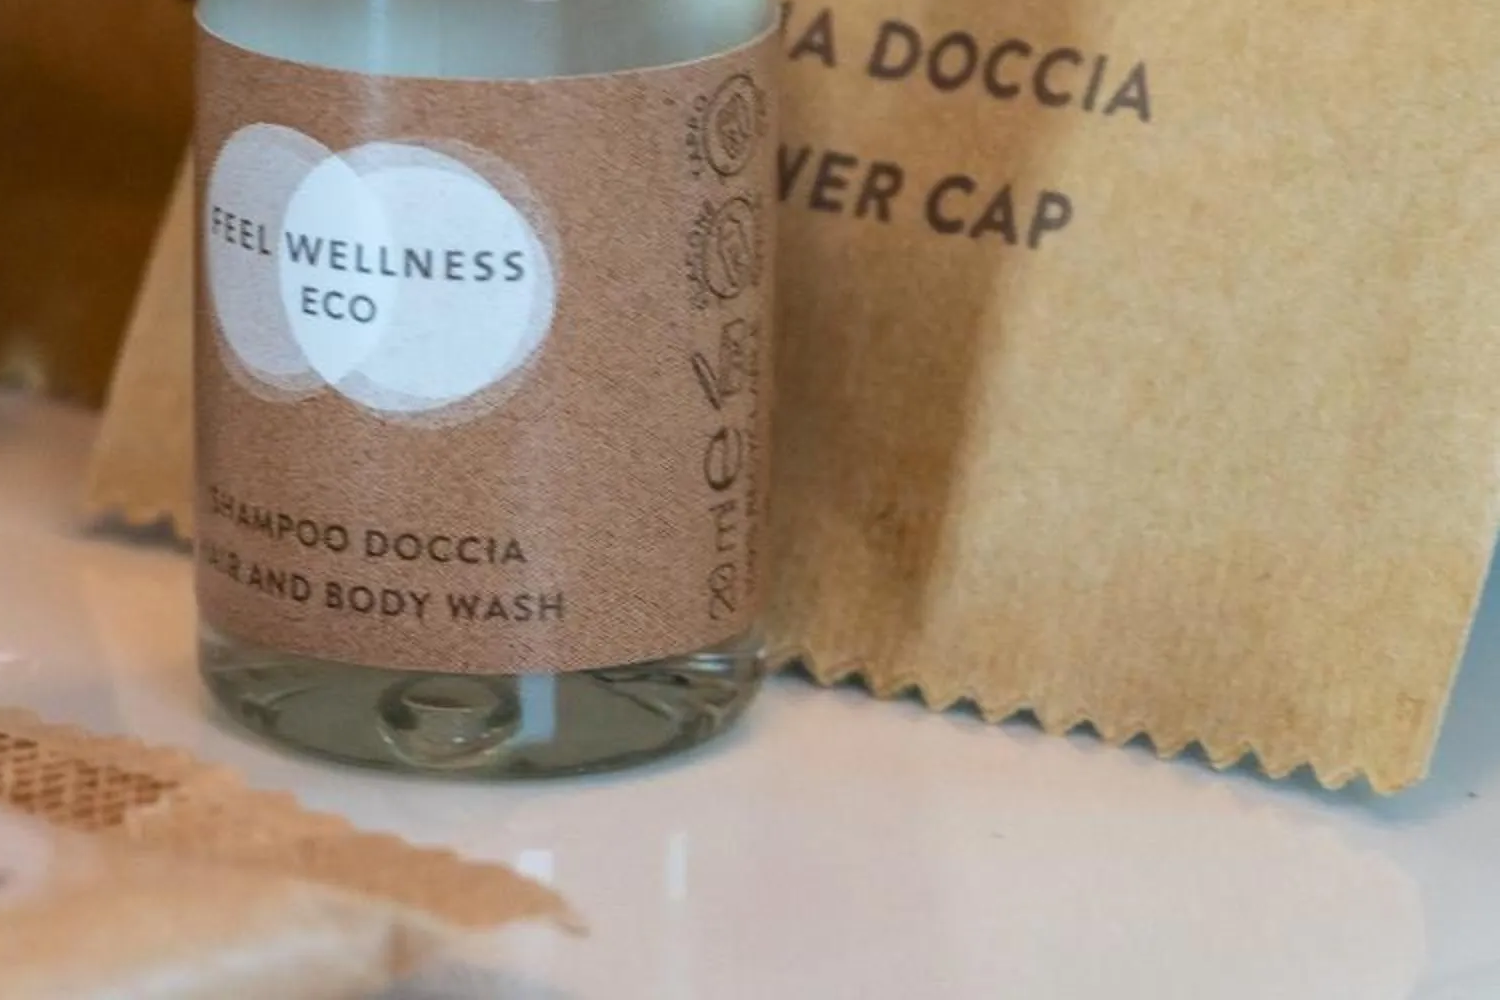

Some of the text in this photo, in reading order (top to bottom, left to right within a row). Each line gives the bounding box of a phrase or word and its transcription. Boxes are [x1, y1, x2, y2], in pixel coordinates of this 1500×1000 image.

[867, 19, 1152, 124] DOCCIA
[211, 205, 526, 283] FEEL WELLNESS
[926, 174, 1074, 250] CAP
[301, 285, 379, 324] ECO
[209, 485, 528, 565] SHAMPOO DOCCIA
[249, 563, 311, 603] AND
[325, 580, 431, 620] BODY
[448, 591, 566, 622] WASH
